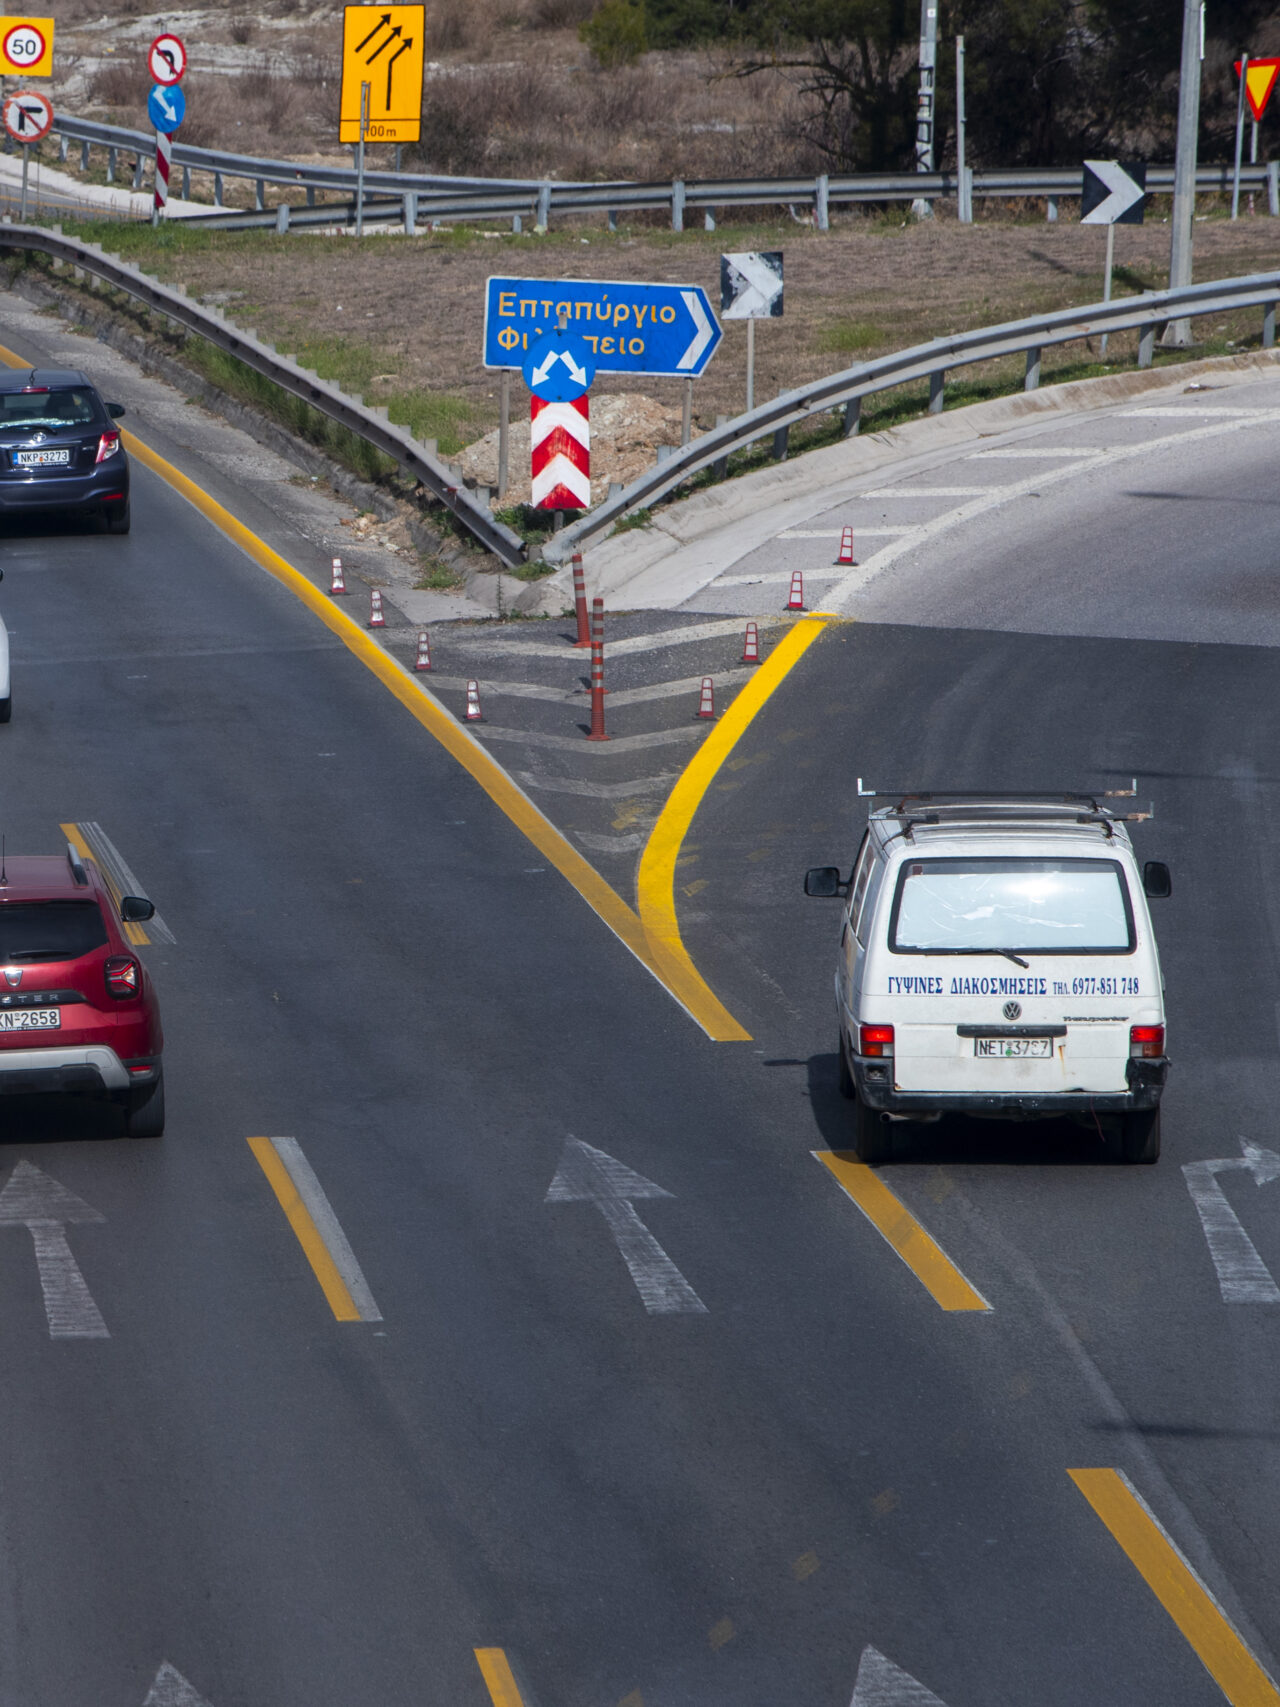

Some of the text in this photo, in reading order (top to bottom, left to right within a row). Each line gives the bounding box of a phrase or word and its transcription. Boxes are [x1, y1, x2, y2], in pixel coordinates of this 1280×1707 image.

[12, 39, 36, 55] 50
[386, 128, 397, 137] m
[498, 291, 676, 328] Επταπύργιο
[498, 325, 645, 355] Φιπειο
[888, 976, 943, 994] ΓΥΨΙΝΕΣ
[950, 977, 1047, 995] ΔΙΑΚΟΣΜΗΣΕΙΣ
[1121, 977, 1139, 995] 748
